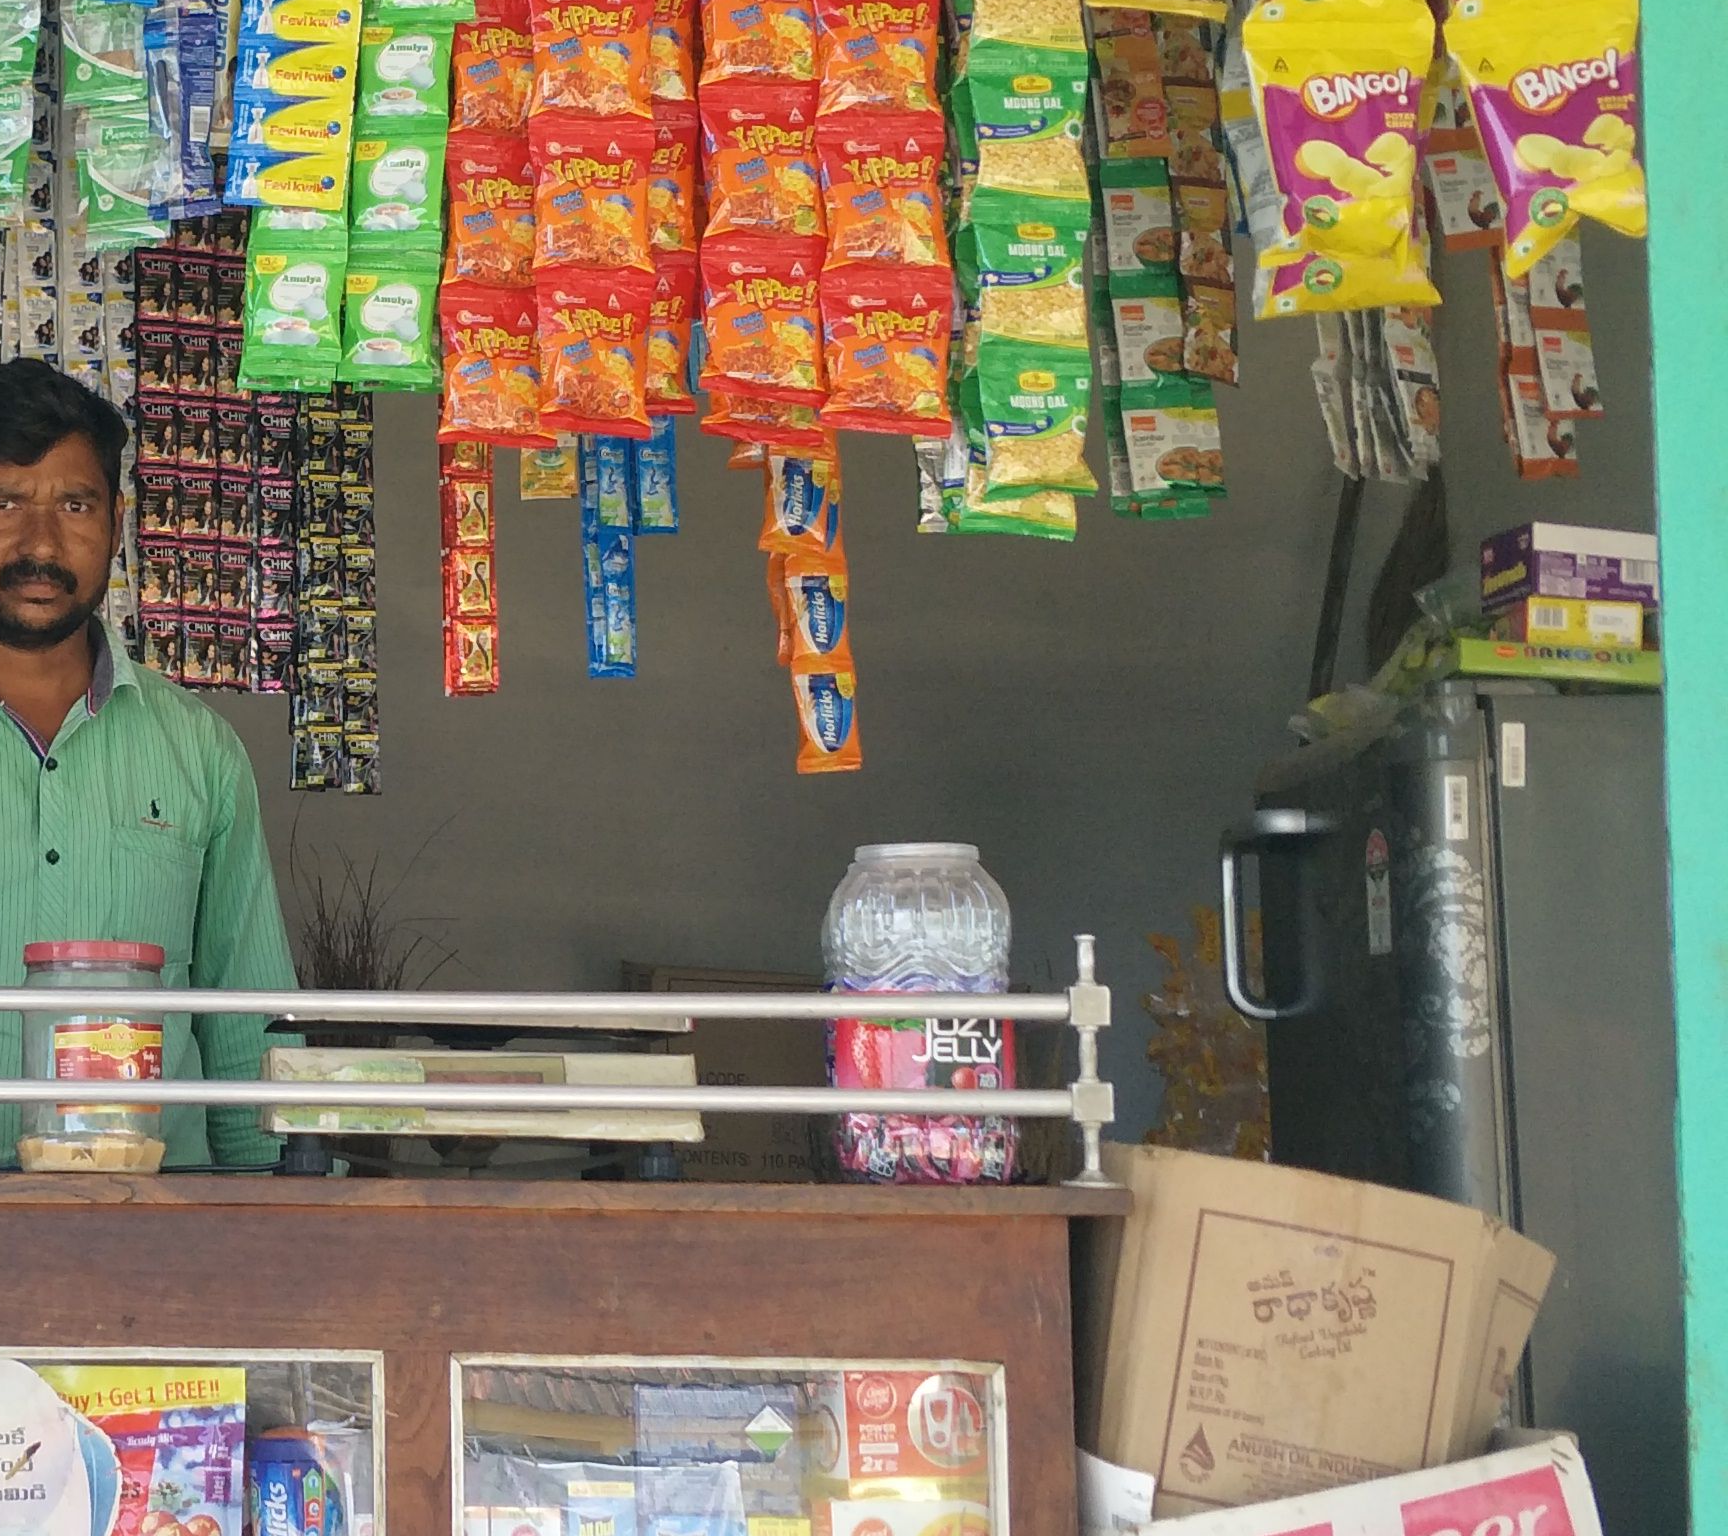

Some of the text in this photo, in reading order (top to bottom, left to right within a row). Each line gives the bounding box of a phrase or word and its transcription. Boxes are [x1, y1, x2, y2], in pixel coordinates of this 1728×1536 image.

[389, 43, 429, 53] Amulya
[1307, 67, 1410, 114] BINGO!
[1516, 48, 1620, 111] BINGO!
[788, 474, 804, 526] Horlicks
[814, 591, 826, 643] Horlicks
[824, 688, 835, 743] Horlicks
[912, 1037, 1002, 1064] JELLY
[109, 1385, 143, 1408] Get
[1228, 1438, 1285, 1463] ANUSH
[1288, 1448, 1314, 1469] OIL
